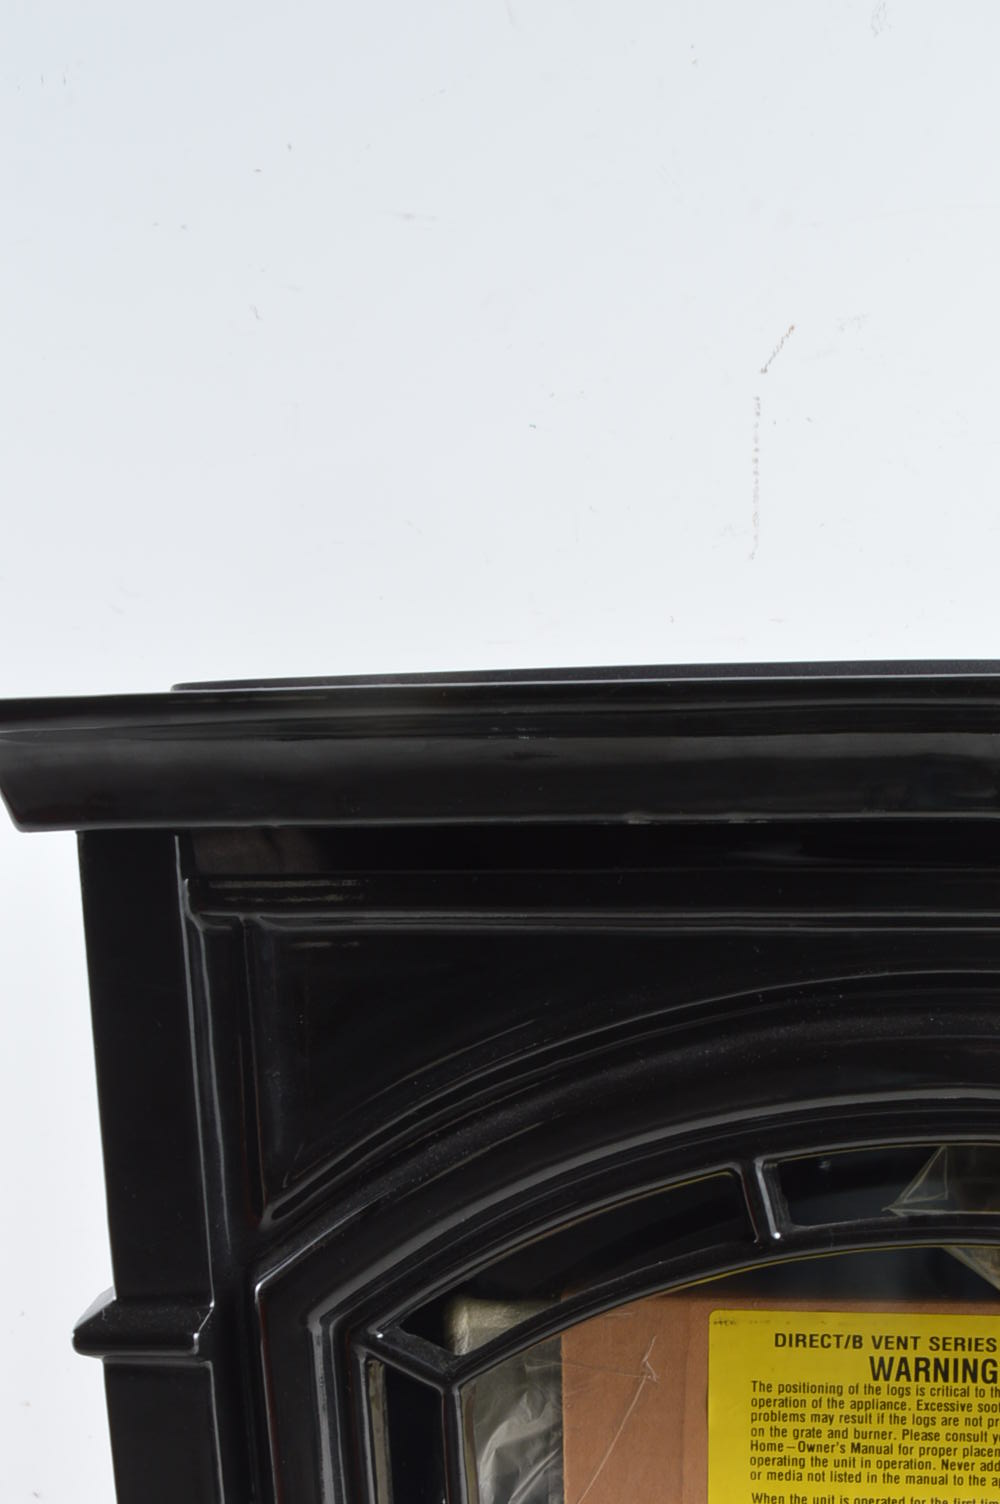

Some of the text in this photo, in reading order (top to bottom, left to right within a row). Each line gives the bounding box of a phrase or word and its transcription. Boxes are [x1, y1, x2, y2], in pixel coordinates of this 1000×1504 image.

[774, 1333, 863, 1350] DIRECT/B
[871, 1335, 921, 1351] VENT
[929, 1336, 997, 1353] SERIES
[869, 1356, 998, 1384] WARNING
[751, 1380, 773, 1393] The
[778, 1382, 843, 1397] positioning
[848, 1383, 859, 1395] of
[863, 1383, 882, 1396] the
[887, 1384, 911, 1399] logs
[915, 1384, 926, 1397] is
[929, 1385, 970, 1398] critical
[974, 1386, 986, 1399] to
[751, 1396, 807, 1409] operation
[811, 1396, 822, 1409] of
[827, 1397, 845, 1409] the
[850, 1398, 911, 1412] appliance.
[916, 1399, 973, 1413] Excessive
[751, 1410, 806, 1423] problems
[810, 1413, 835, 1426] may
[839, 1412, 872, 1424] result
[877, 1412, 885, 1425] if
[889, 1413, 907, 1426] the
[912, 1413, 937, 1428] logs
[941, 1416, 960, 1427] are
[964, 1415, 983, 1427] not
[751, 1427, 765, 1437] on
[769, 1425, 788, 1438] the
[792, 1427, 822, 1440] grate
[827, 1427, 849, 1440] and
[853, 1427, 897, 1440] burner.
[902, 1428, 940, 1442] Please
[945, 1431, 988, 1443] consult
[850, 1442, 893, 1455] Manual
[898, 1443, 914, 1456] for
[919, 1446, 958, 1458] proper
[750, 1455, 806, 1469] operating
[810, 1455, 829, 1468] the
[833, 1456, 856, 1468] unit
[860, 1457, 871, 1469] in
[876, 1458, 936, 1471] operation.
[941, 1459, 976, 1471] Never
[979, 1460, 1000, 1472] add
[750, 1471, 762, 1481] or
[766, 1469, 803, 1482] media
[807, 1471, 825, 1482] not
[830, 1471, 862, 1484] listed
[866, 1472, 877, 1483] in
[882, 1472, 900, 1485] the
[905, 1474, 948, 1486] manual
[953, 1474, 964, 1486] to
[968, 1474, 987, 1487] the
[751, 1493, 785, 1504] When
